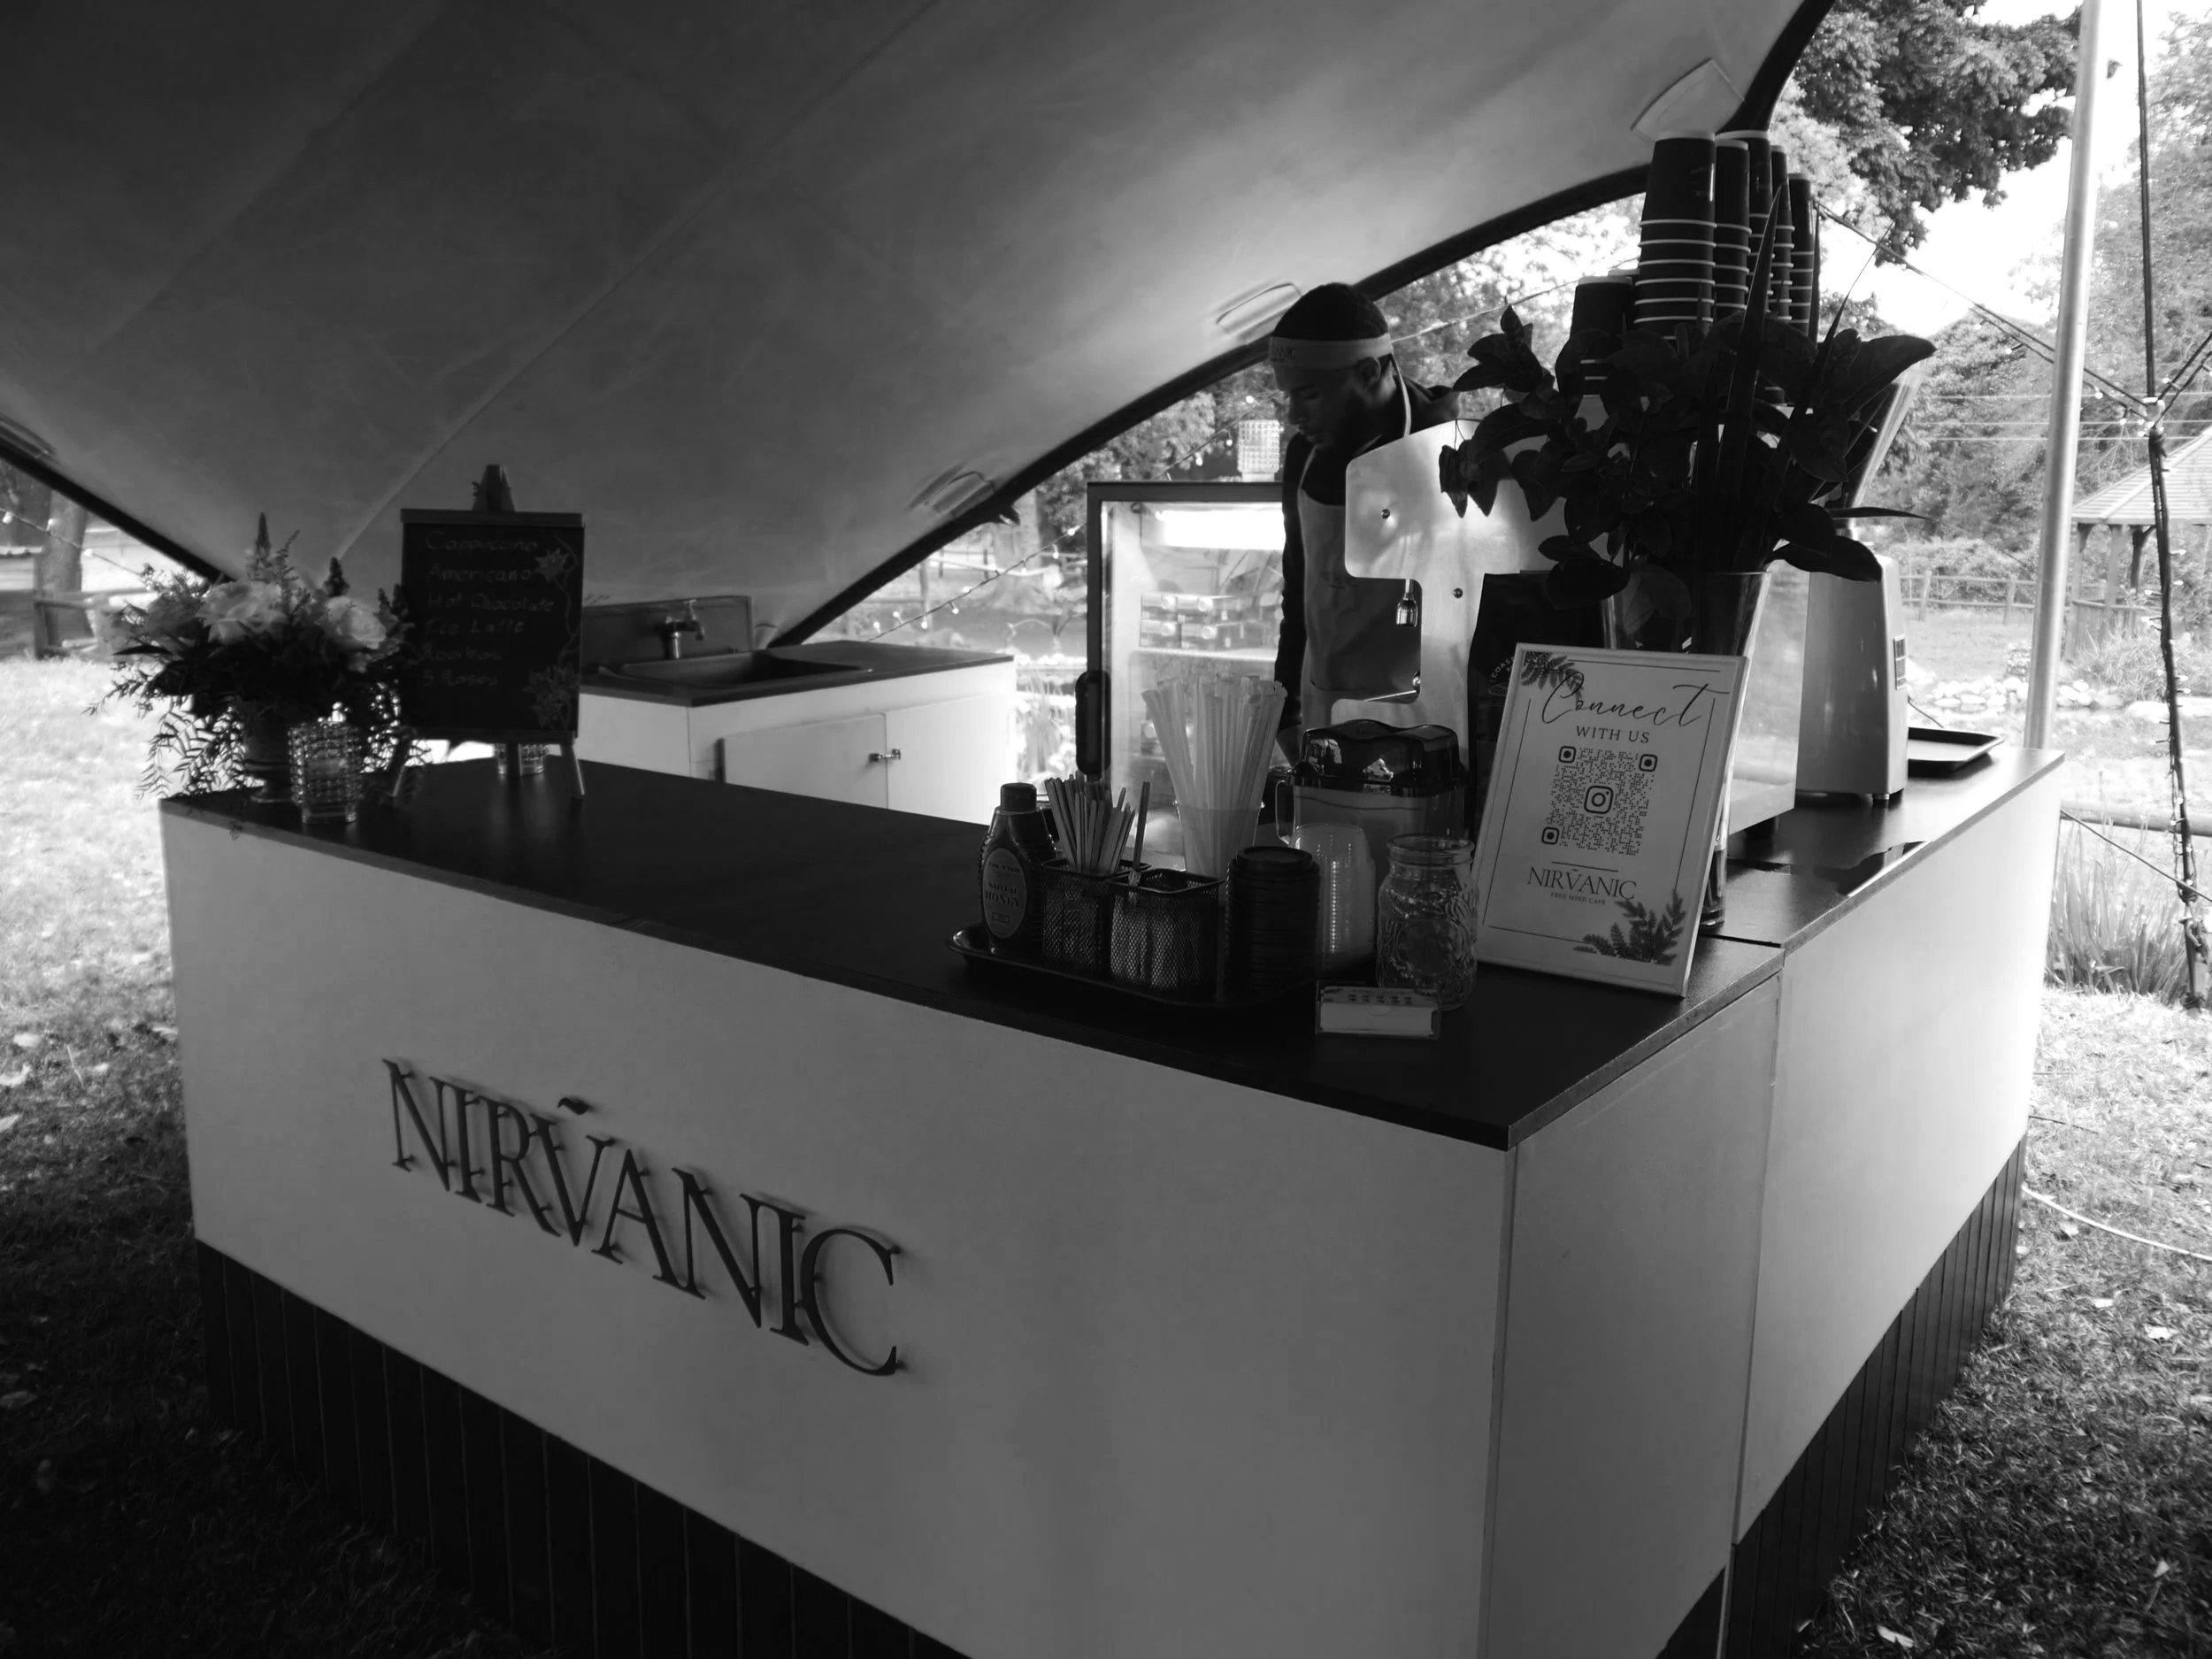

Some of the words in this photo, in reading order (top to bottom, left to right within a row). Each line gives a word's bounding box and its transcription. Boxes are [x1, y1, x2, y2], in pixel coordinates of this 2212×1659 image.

[426, 562, 532, 583] Americano
[426, 592, 462, 608] Hot
[470, 591, 556, 612] Chocolate
[1542, 672, 1730, 726] Connect
[1575, 725, 1621, 741] WITH
[1628, 729, 1651, 744] US
[1527, 867, 1637, 900] NIRVANIC
[986, 890, 1019, 906] HONEY
[382, 1058, 897, 1377] NIRVANIC
